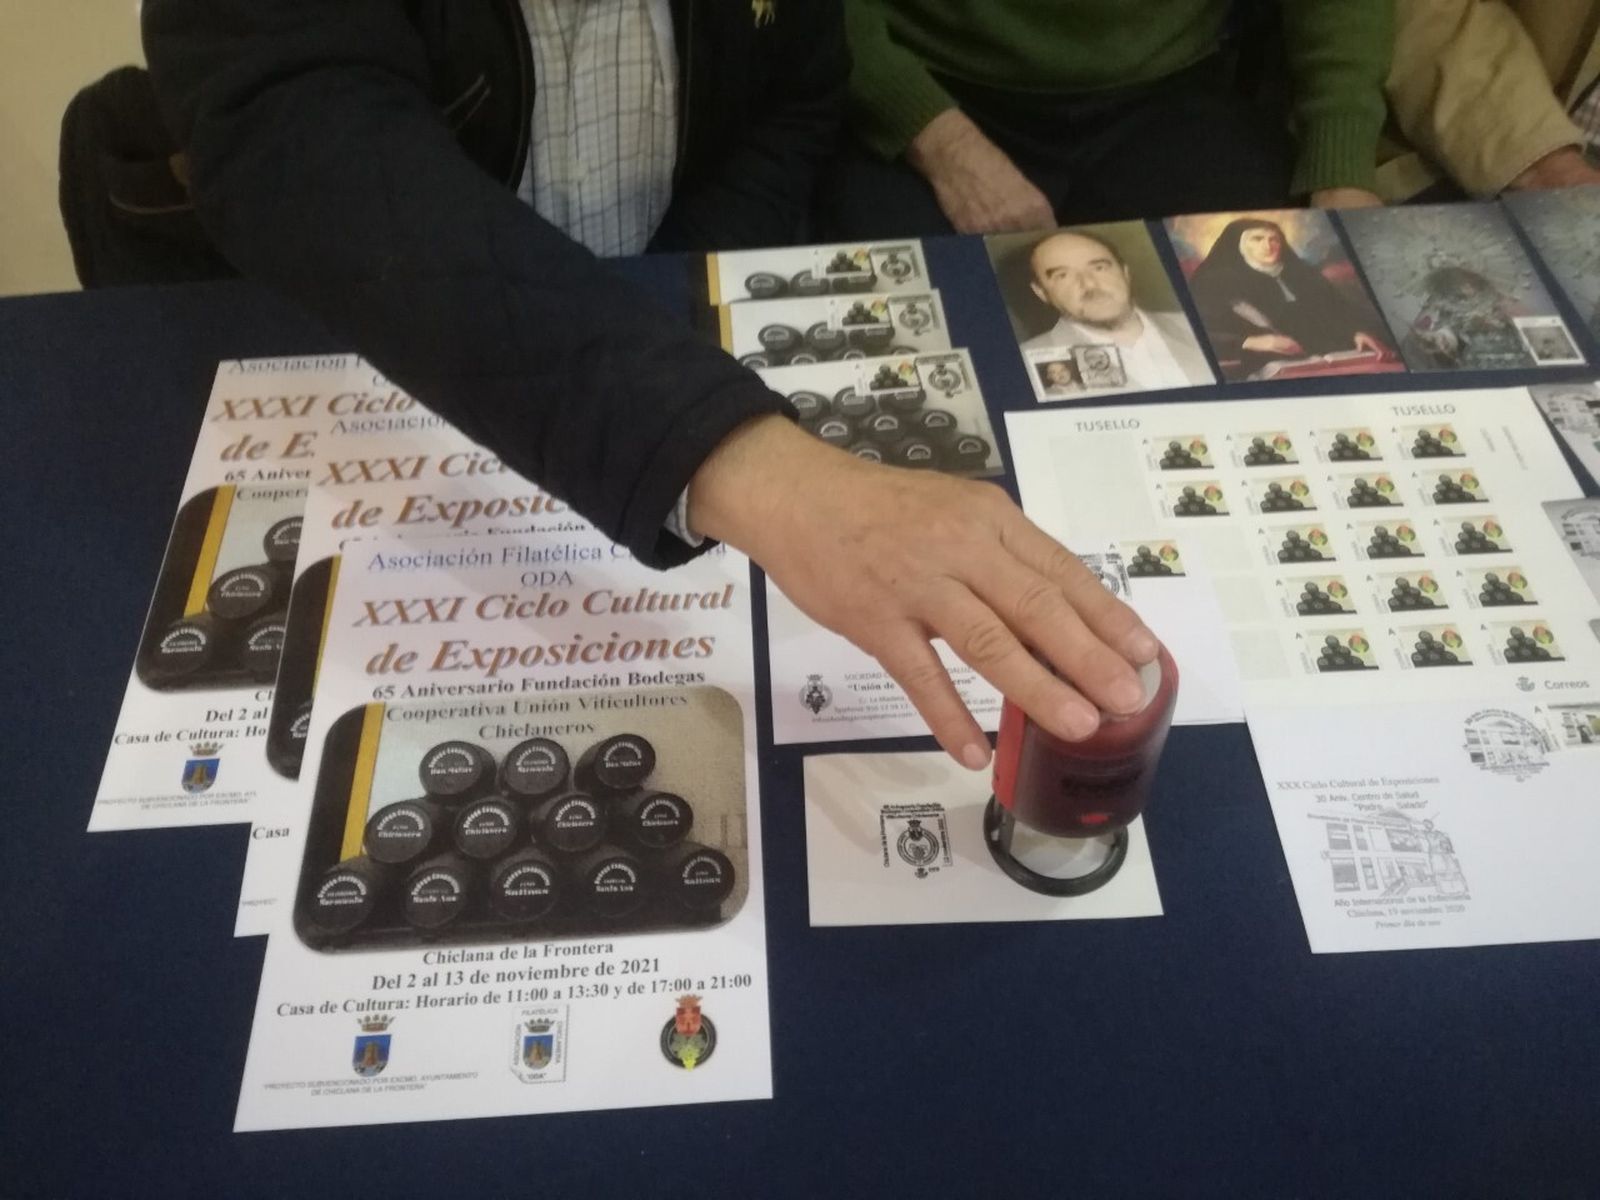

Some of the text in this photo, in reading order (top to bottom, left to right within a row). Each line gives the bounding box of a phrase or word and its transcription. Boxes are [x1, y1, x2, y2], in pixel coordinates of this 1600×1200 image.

[211, 394, 320, 422] XXXI
[1391, 403, 1456, 417] TUSELLO
[1075, 418, 1140, 432] TUSELLO
[219, 434, 270, 462] de
[224, 470, 247, 482] 65
[316, 455, 428, 486] XXXI
[332, 493, 575, 530] de Exposic
[368, 549, 493, 571] Asociación
[502, 542, 602, 566] Filatélica
[520, 570, 574, 588] ODA
[353, 583, 735, 627] XXXI Ciclo Cultural
[366, 632, 716, 679] de Exposiciones
[373, 670, 706, 700] 65 Aniversario Fundación Bodegas
[884, 682, 895, 690] de
[1544, 680, 1590, 690] Correos
[205, 707, 268, 723] Del 2 al
[386, 693, 689, 722] Cooperativa Unión Viticultores
[114, 733, 152, 746] Casa
[154, 730, 172, 744] de
[176, 727, 240, 742] Cultura:
[478, 720, 596, 739] Chiclaneros
[252, 827, 290, 841] Casa
[422, 940, 614, 966] Chiclana de la Frontera
[372, 957, 661, 992] Del 2 al 13 de noviembre de 2021
[276, 973, 753, 1018] Casa de Cultura: Horario de 11:00 a 13:30 y de 17:00 a 21:00
